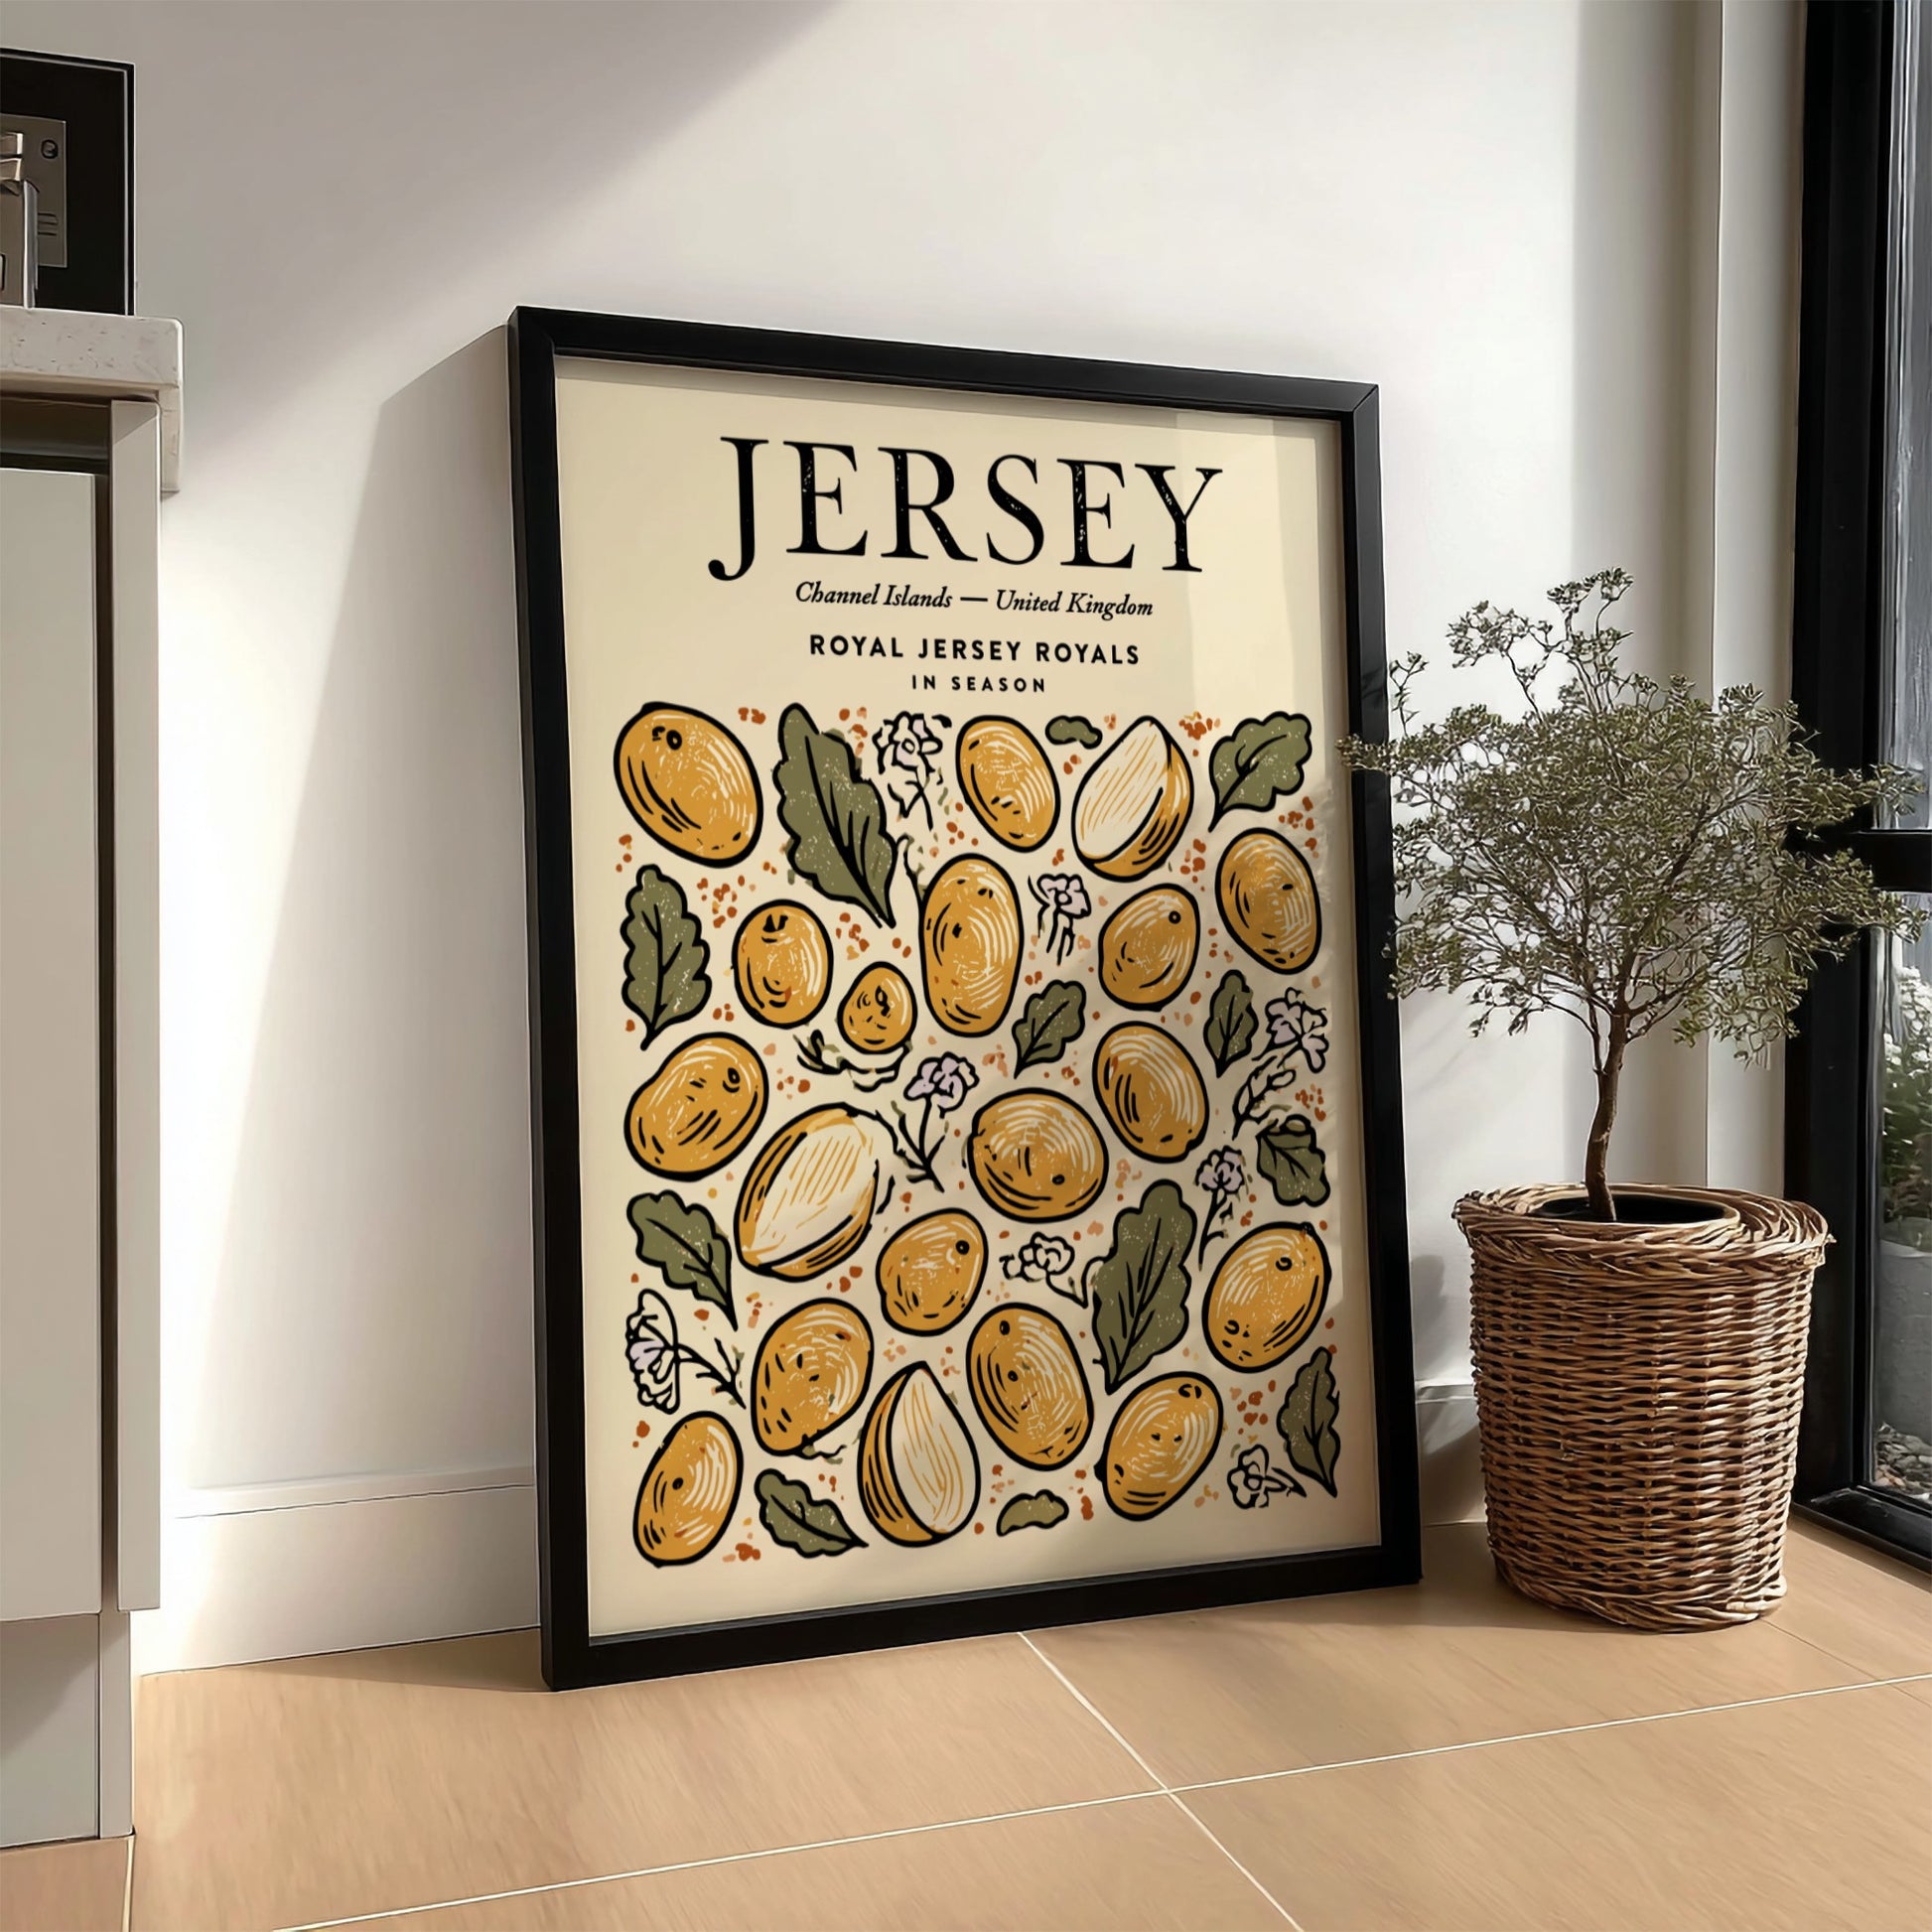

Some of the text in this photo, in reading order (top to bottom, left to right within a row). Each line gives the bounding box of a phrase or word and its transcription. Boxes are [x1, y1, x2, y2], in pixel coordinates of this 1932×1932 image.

[708, 437, 1223, 582] JERSEY
[795, 581, 881, 606] Channel
[883, 585, 953, 608] Islands
[996, 589, 1061, 613] United
[1066, 593, 1153, 621] Kingdom
[809, 634, 1139, 664] ROYAL JERSEY ROYALS
[911, 674, 1044, 693] IN SEASON
